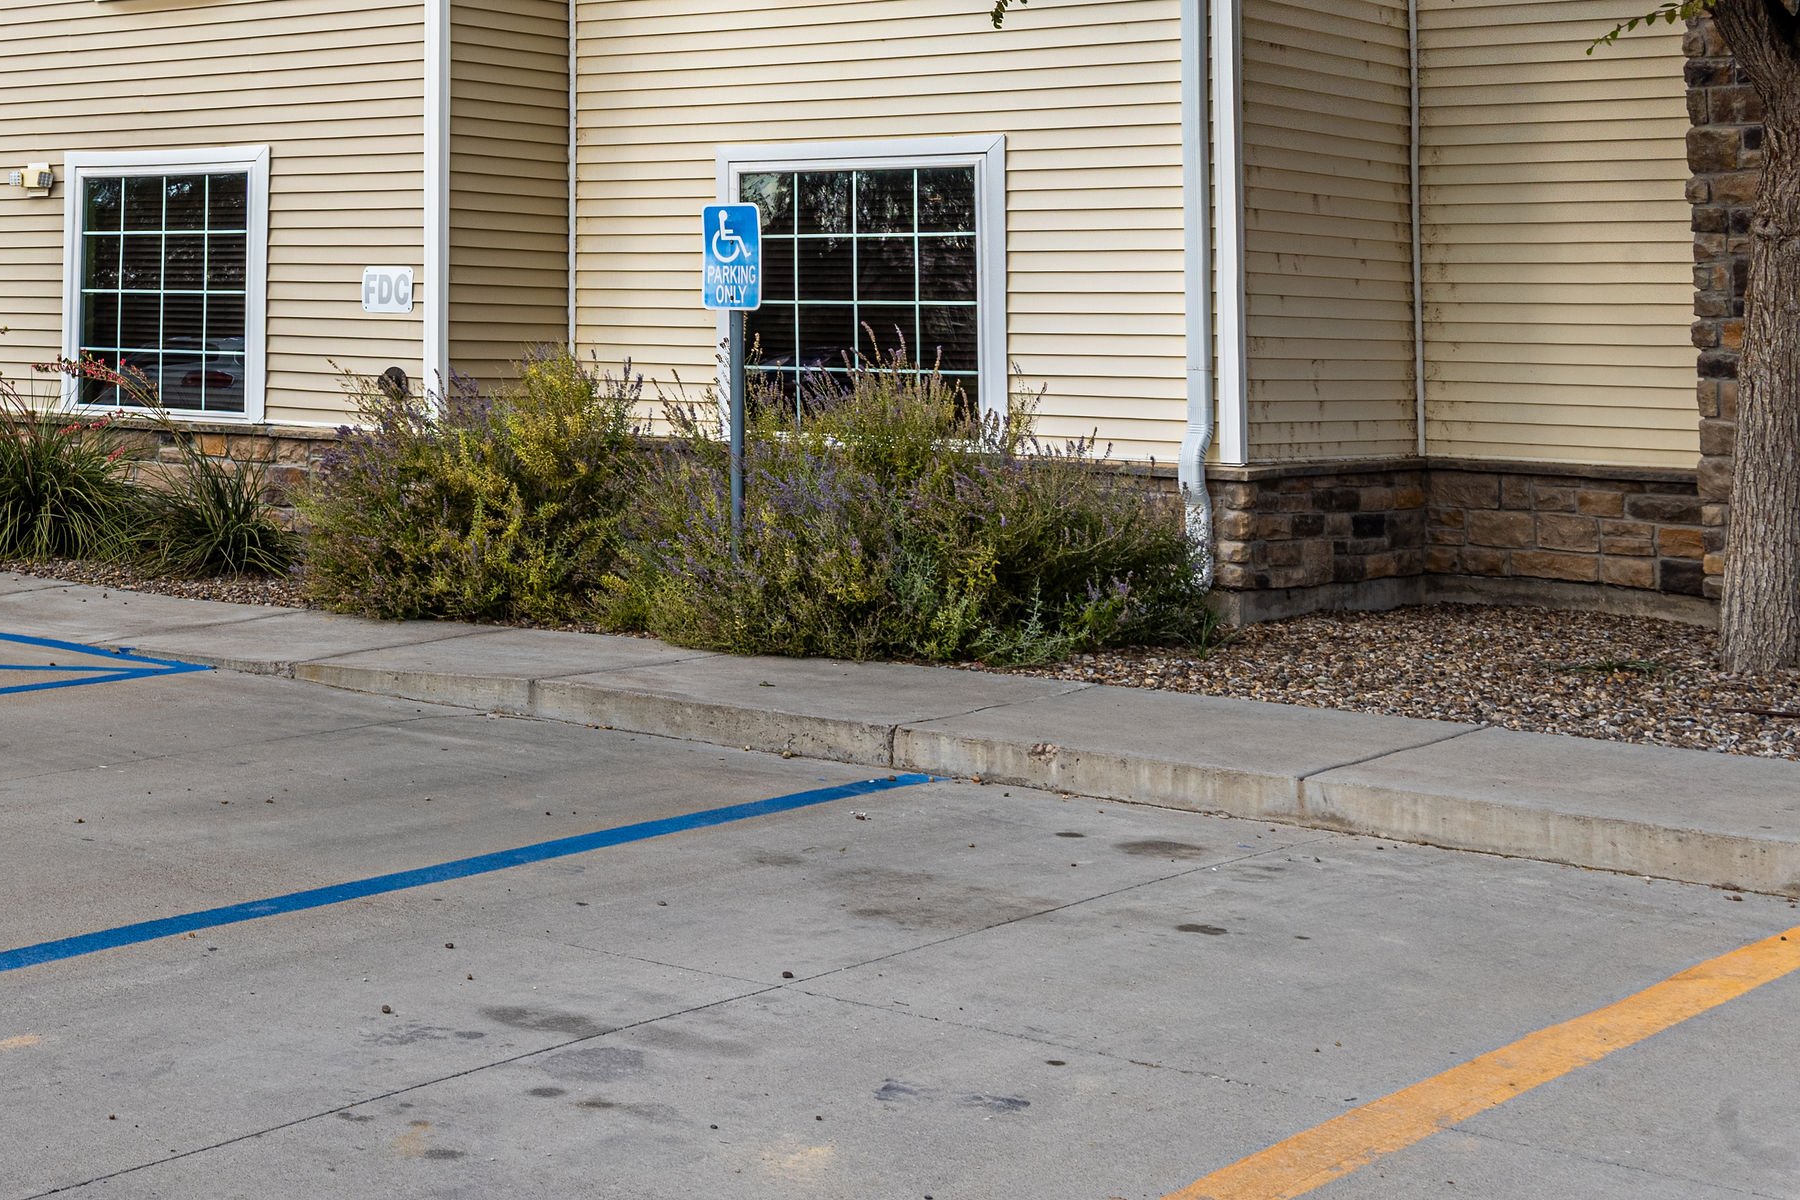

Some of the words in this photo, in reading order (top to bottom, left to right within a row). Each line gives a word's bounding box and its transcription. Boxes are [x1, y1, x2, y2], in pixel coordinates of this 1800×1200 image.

[707, 265, 756, 284] PARKING
[364, 273, 410, 306] FDC
[715, 285, 748, 304] ONLY
